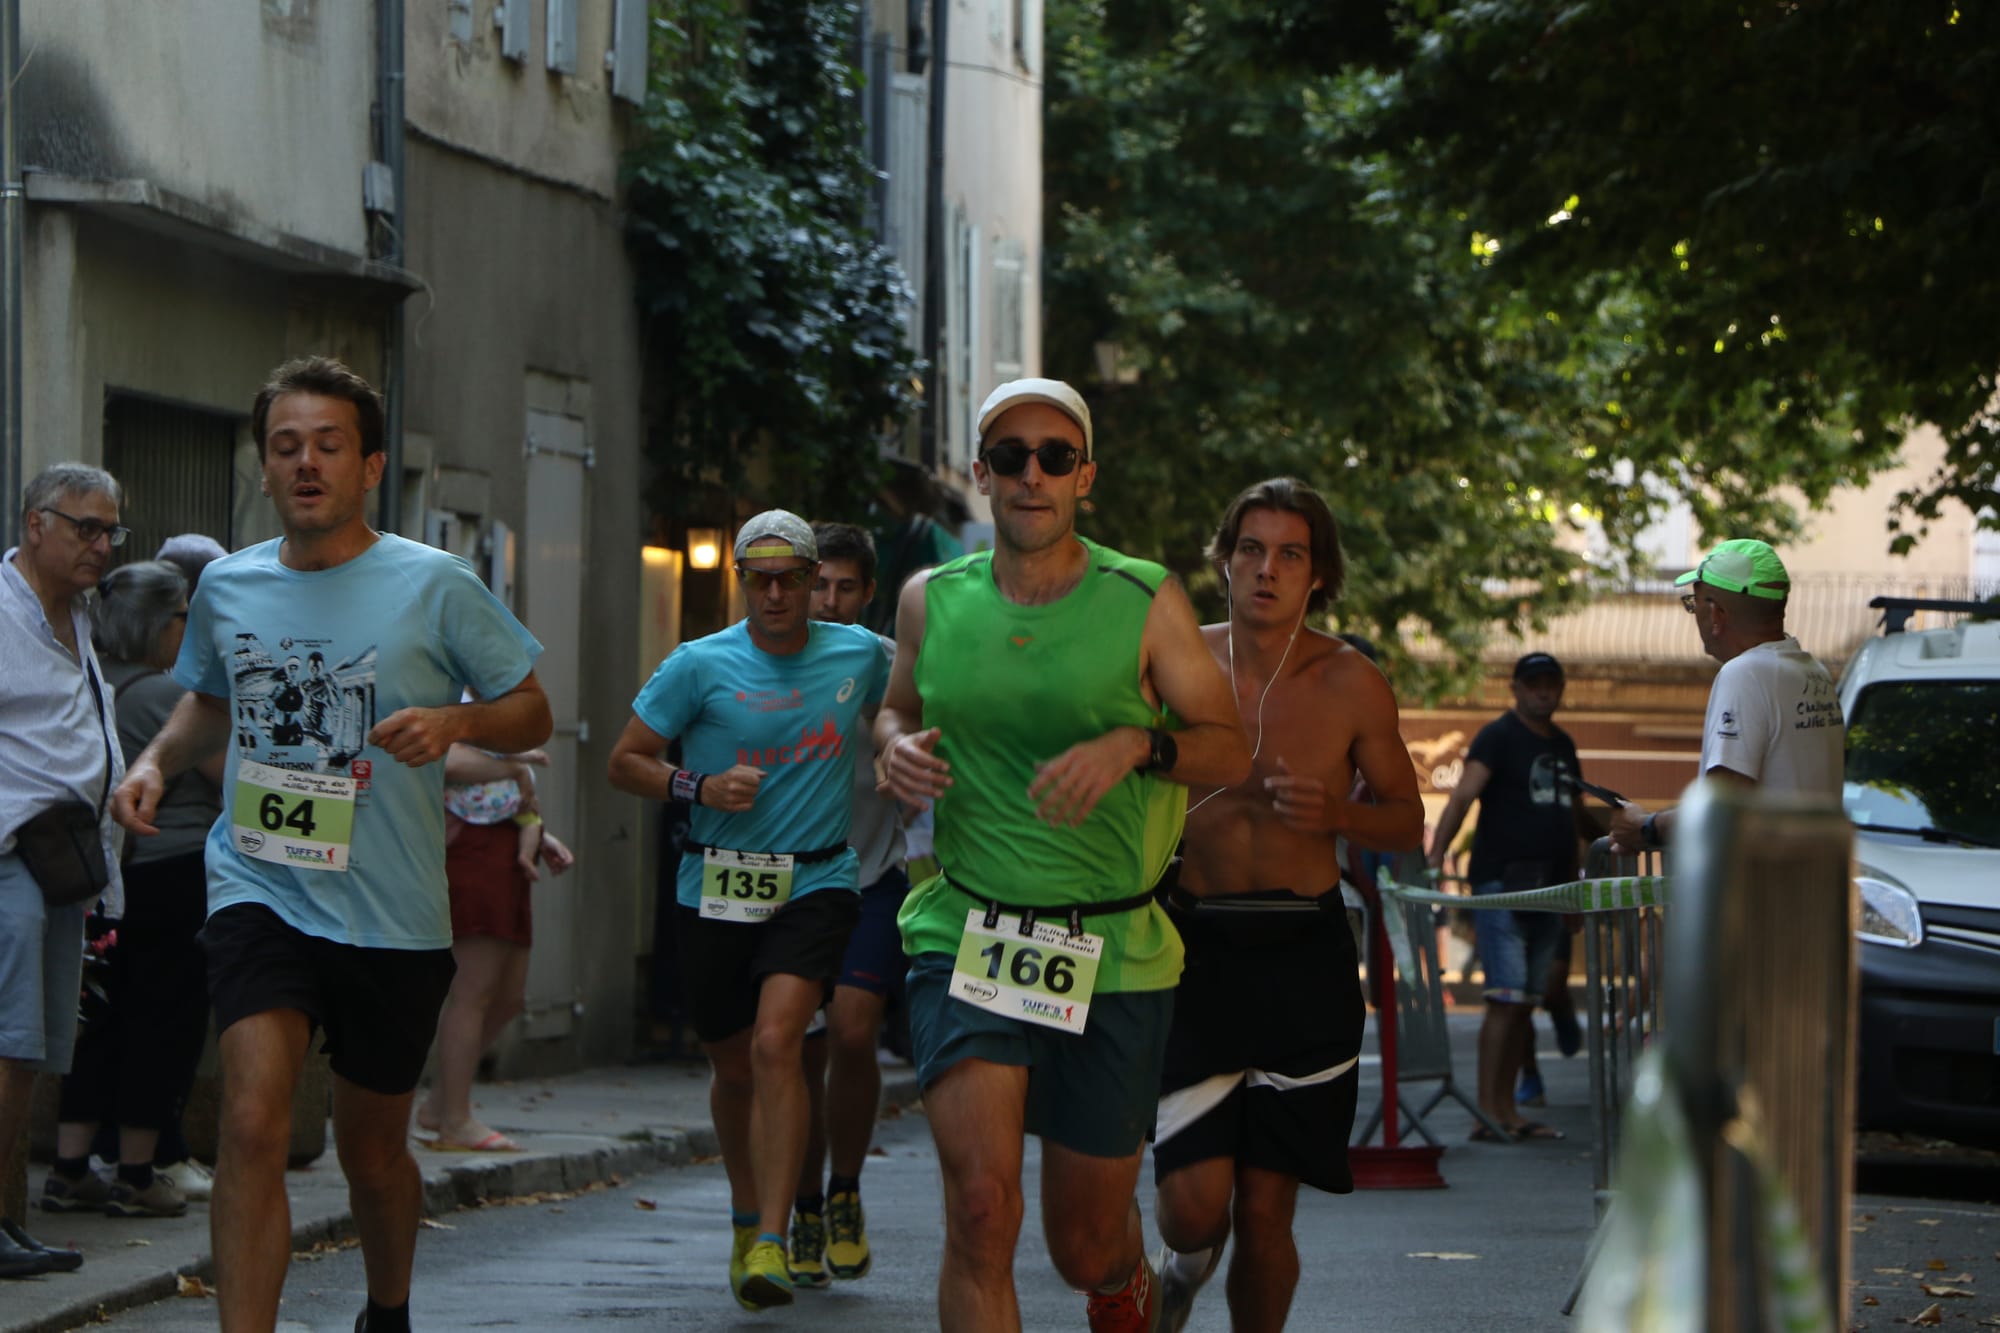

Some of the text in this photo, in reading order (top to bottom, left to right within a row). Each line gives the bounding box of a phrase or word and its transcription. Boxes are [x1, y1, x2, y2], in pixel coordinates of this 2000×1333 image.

[259, 793, 316, 837] 64
[285, 846, 322, 857] TUFF'S
[716, 869, 778, 901] 135
[980, 941, 1077, 994] 166
[1021, 998, 1061, 1014] TUFF'S
